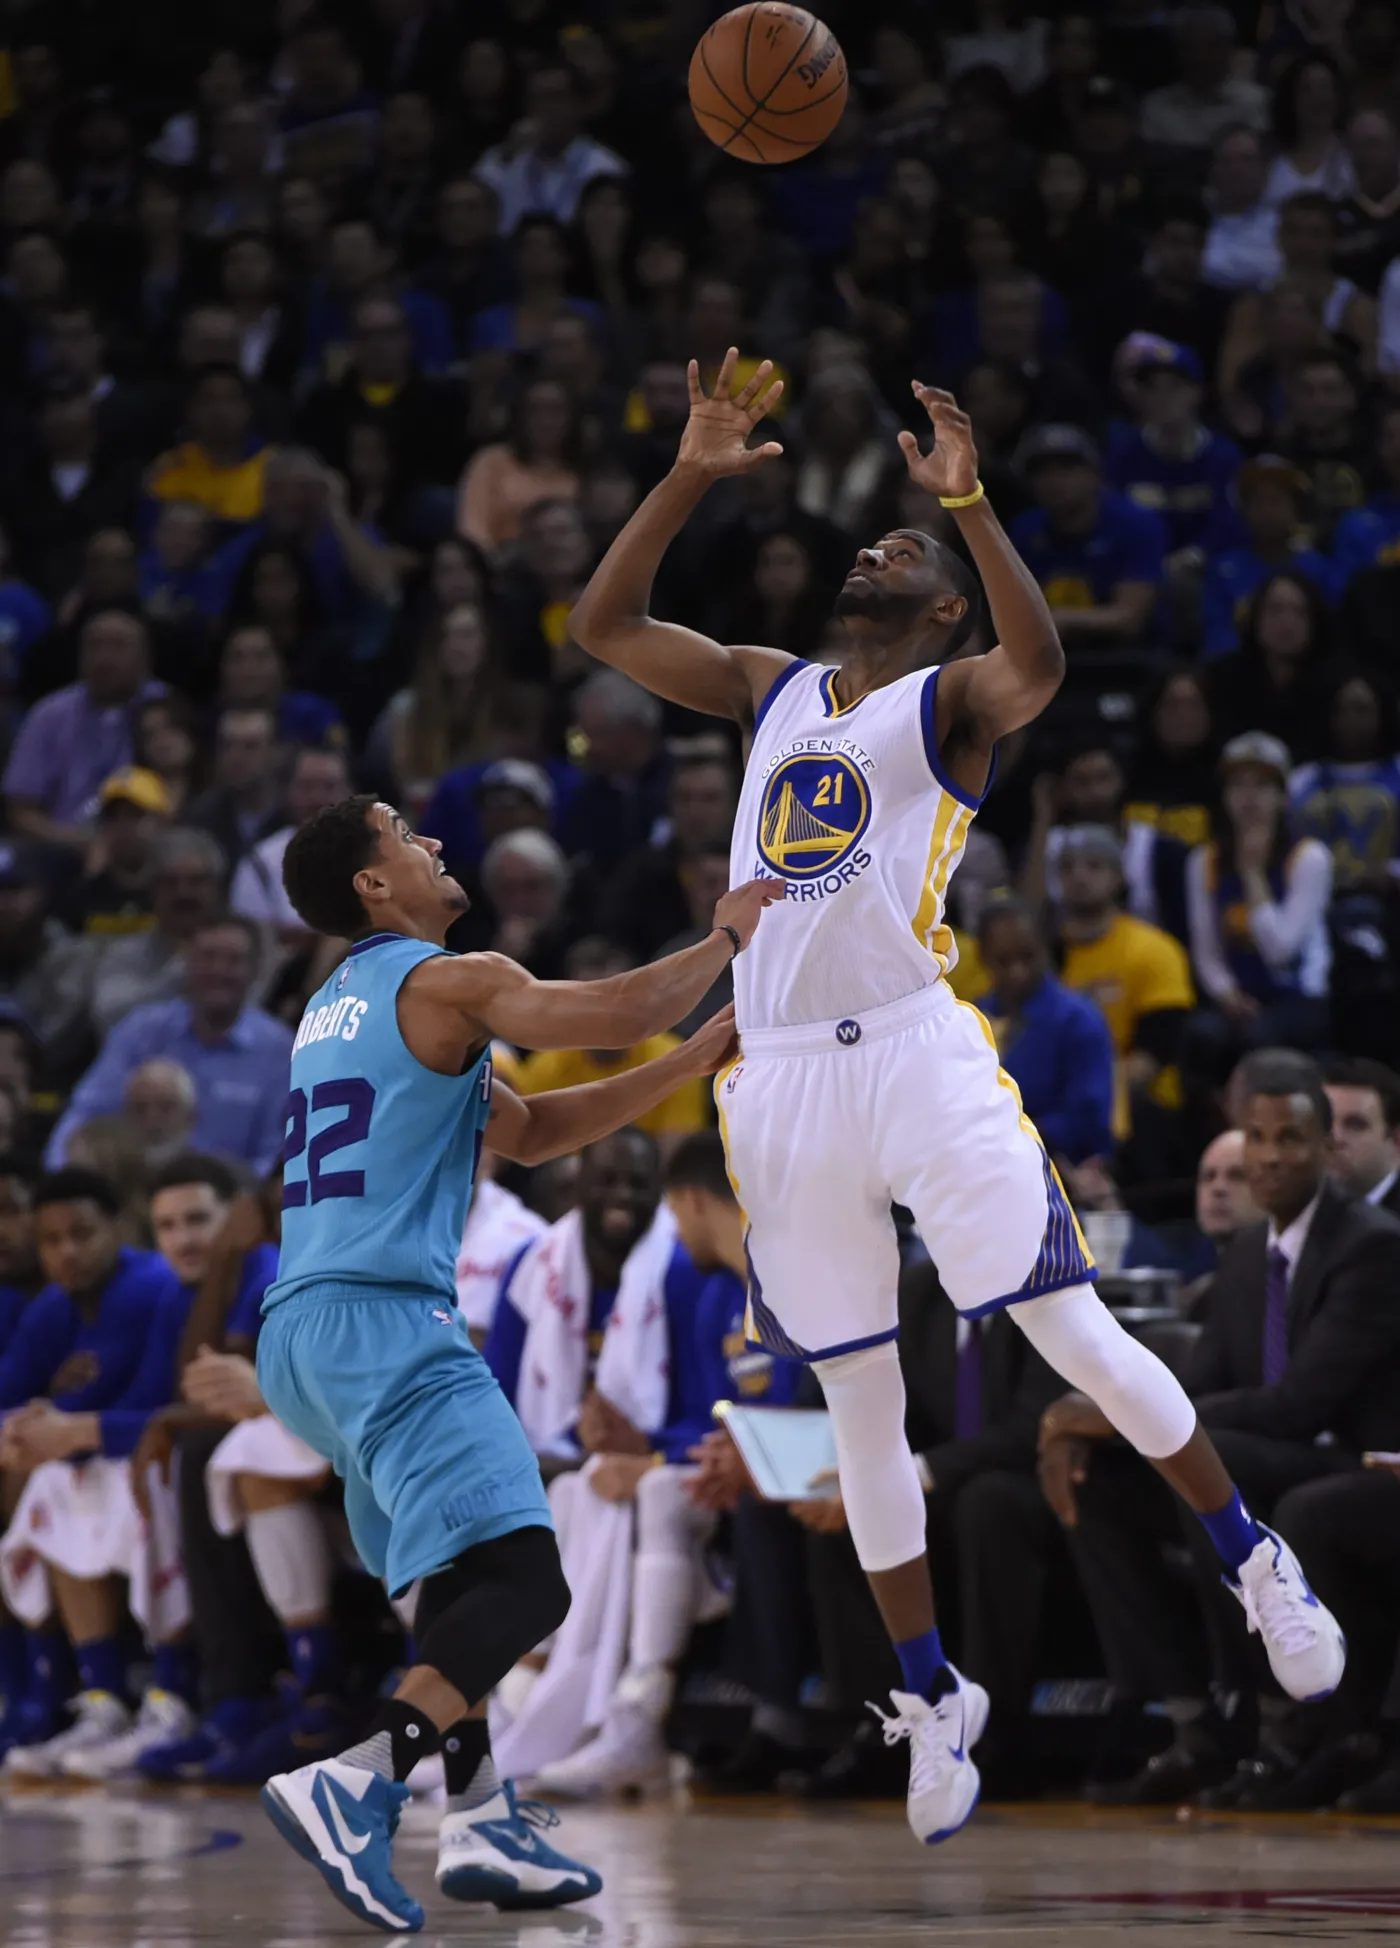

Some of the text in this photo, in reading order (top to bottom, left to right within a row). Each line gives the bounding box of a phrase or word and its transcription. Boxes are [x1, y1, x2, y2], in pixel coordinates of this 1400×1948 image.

[762, 740, 833, 780] GOLDEN
[812, 772, 844, 807] 21
[754, 848, 872, 902] WRRIORS
[291, 995, 368, 1061] OBERTS
[839, 1025, 858, 1041] W
[281, 1077, 377, 1211] 22
